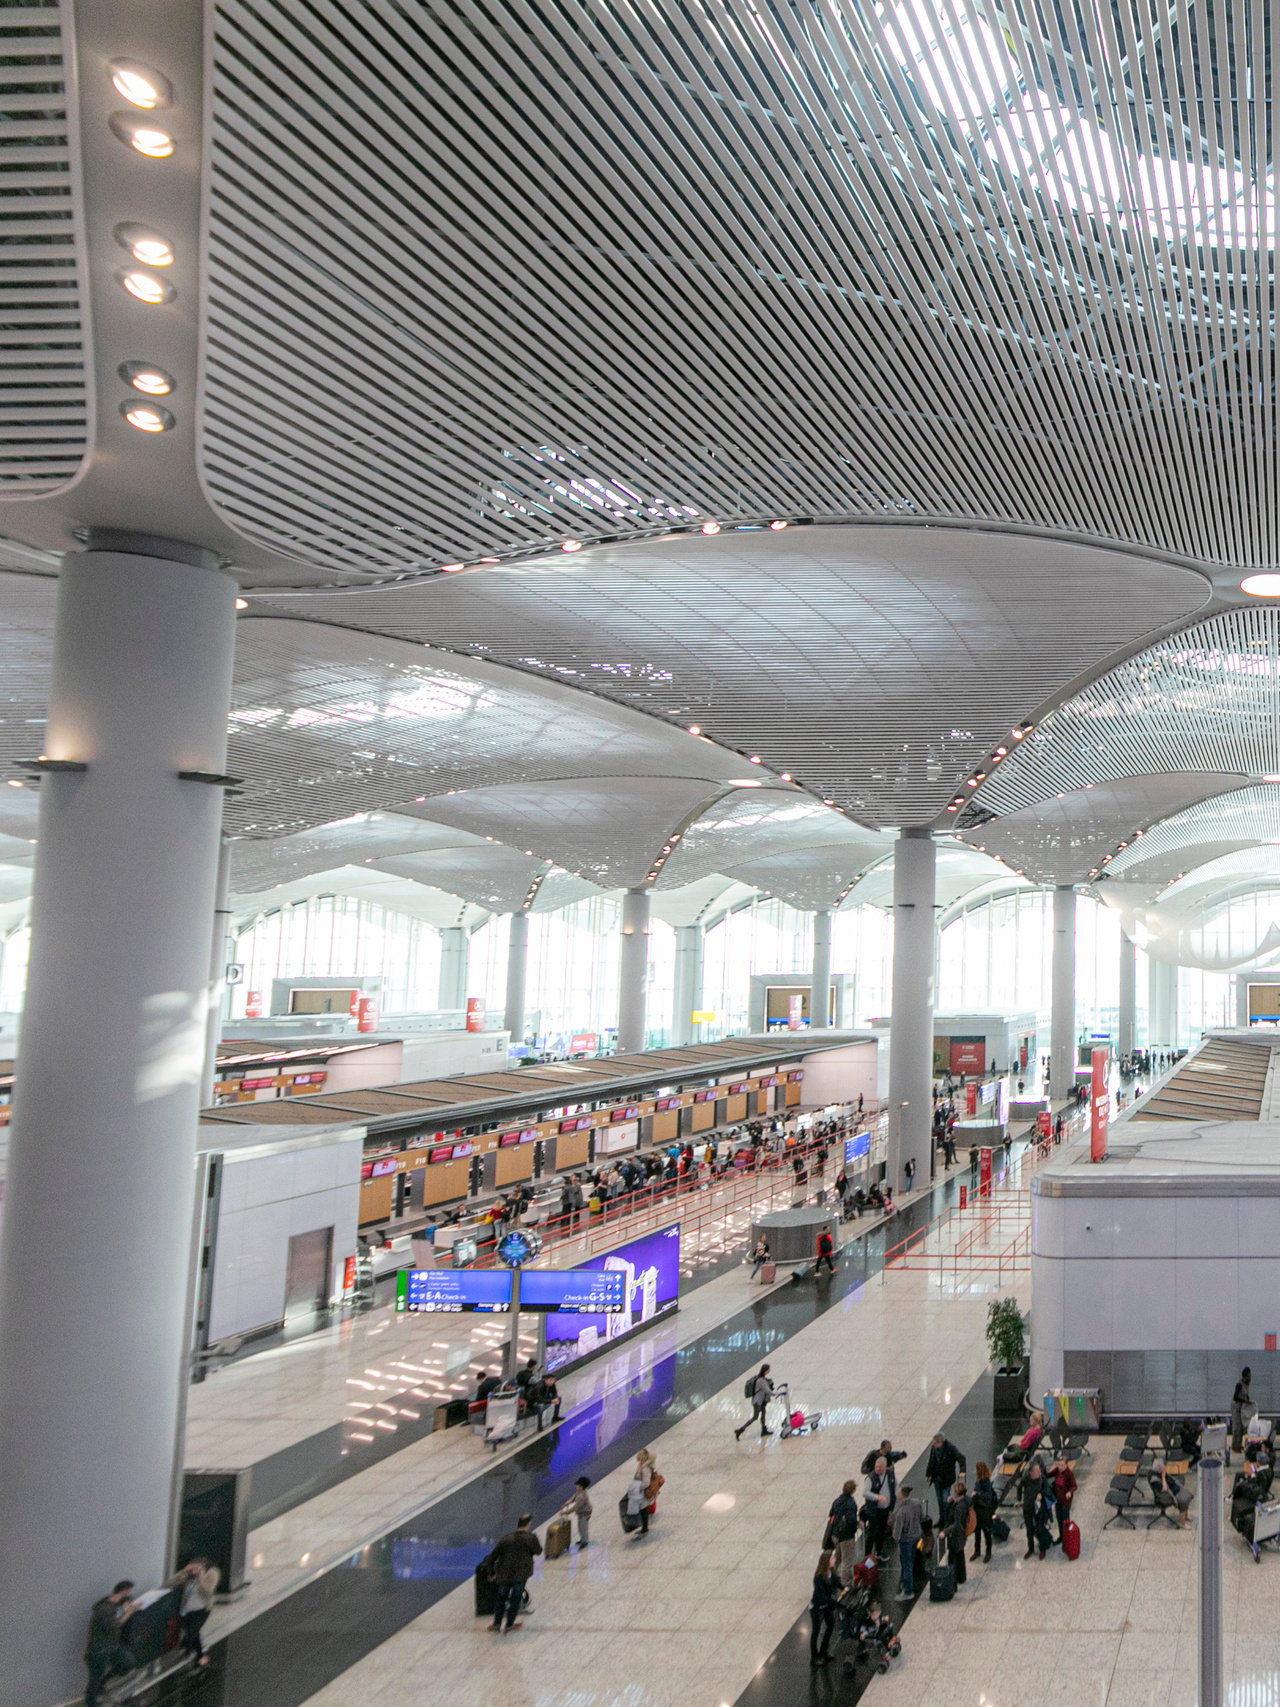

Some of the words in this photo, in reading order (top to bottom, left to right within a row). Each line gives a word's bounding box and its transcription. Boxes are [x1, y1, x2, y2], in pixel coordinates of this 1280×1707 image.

[496, 1039, 503, 1051] E
[426, 1291, 441, 1300] E-A
[564, 1293, 588, 1301] Check-in
[589, 1292, 605, 1301] G-S
